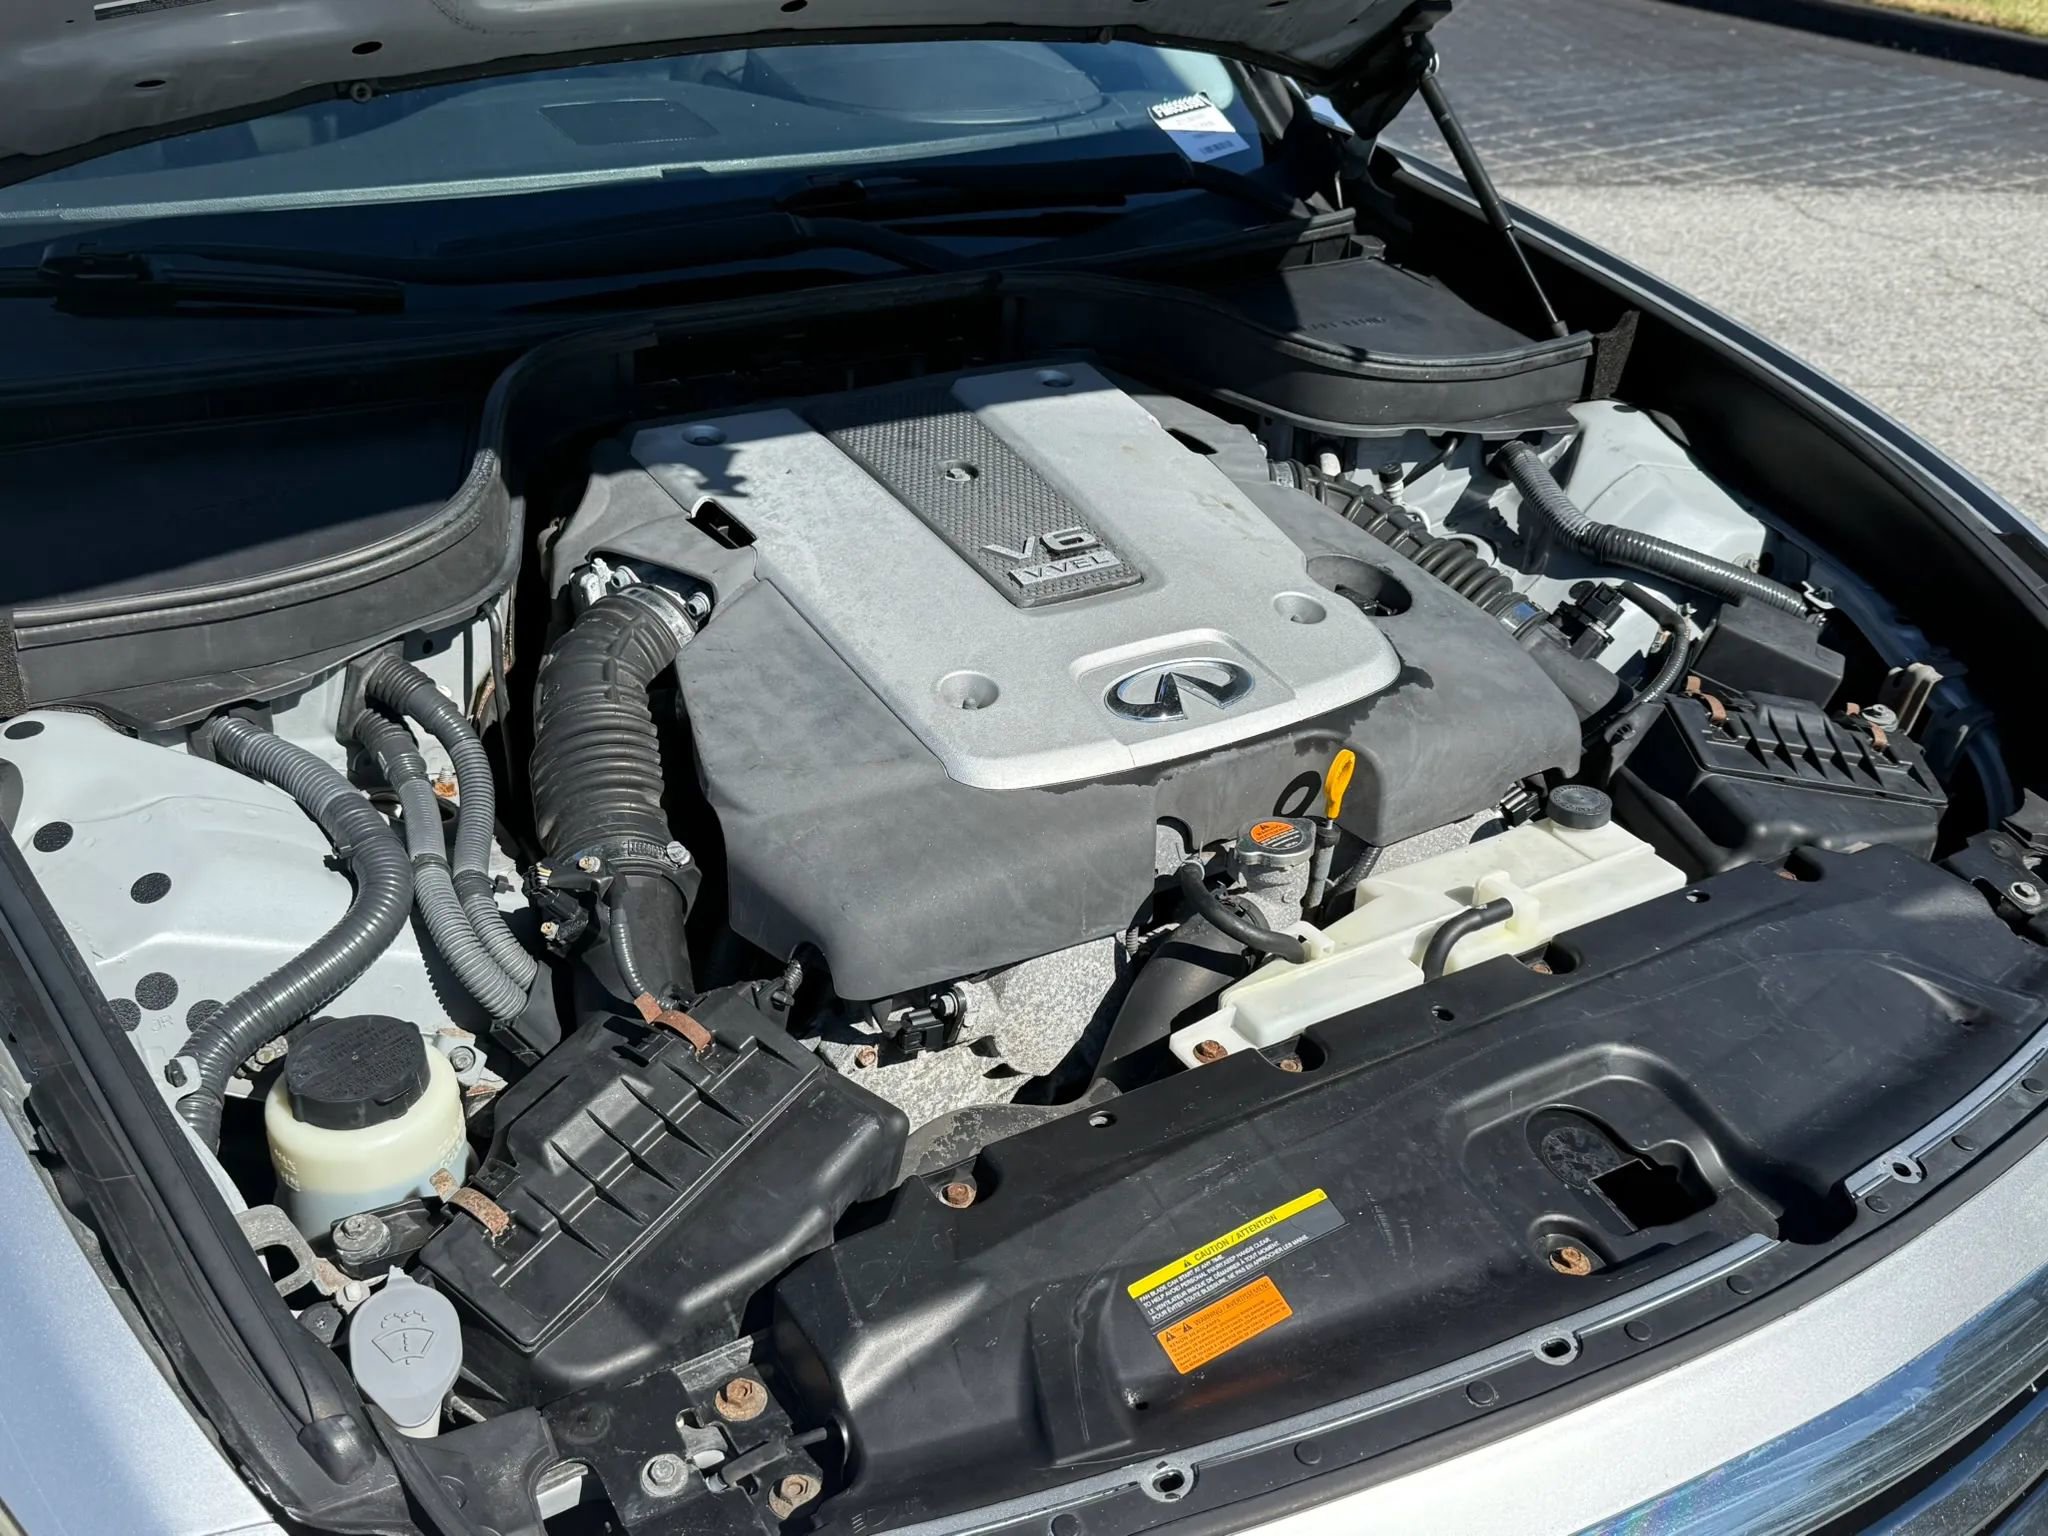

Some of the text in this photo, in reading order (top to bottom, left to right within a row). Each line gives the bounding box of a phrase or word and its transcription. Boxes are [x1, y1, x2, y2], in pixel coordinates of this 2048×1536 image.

[982, 526, 1099, 562] V6
[1023, 555, 1111, 578] VVEL
[1192, 1238, 1230, 1261] CAUTION
[1234, 1212, 1278, 1239] ATTENTION
[1142, 1299, 1151, 1308] TO
[1150, 1292, 1165, 1303] HELP
[1164, 1284, 1181, 1296] AVOID
[1179, 1270, 1207, 1288] PERSONAL
[1235, 1245, 1254, 1258] HANDS
[1146, 1307, 1155, 1315] LE
[1153, 1290, 1187, 1311] VENTILATEUR
[1243, 1252, 1258, 1263] TOUT
[1149, 1284, 1167, 1296] BLADE
[1166, 1278, 1179, 1287] CAN
[1177, 1269, 1194, 1281] START
[1151, 1309, 1168, 1321] POUR
[1183, 1290, 1201, 1303] TOUTE
[1234, 1266, 1246, 1276] PAS
[1252, 1246, 1284, 1266] APPROCHER
